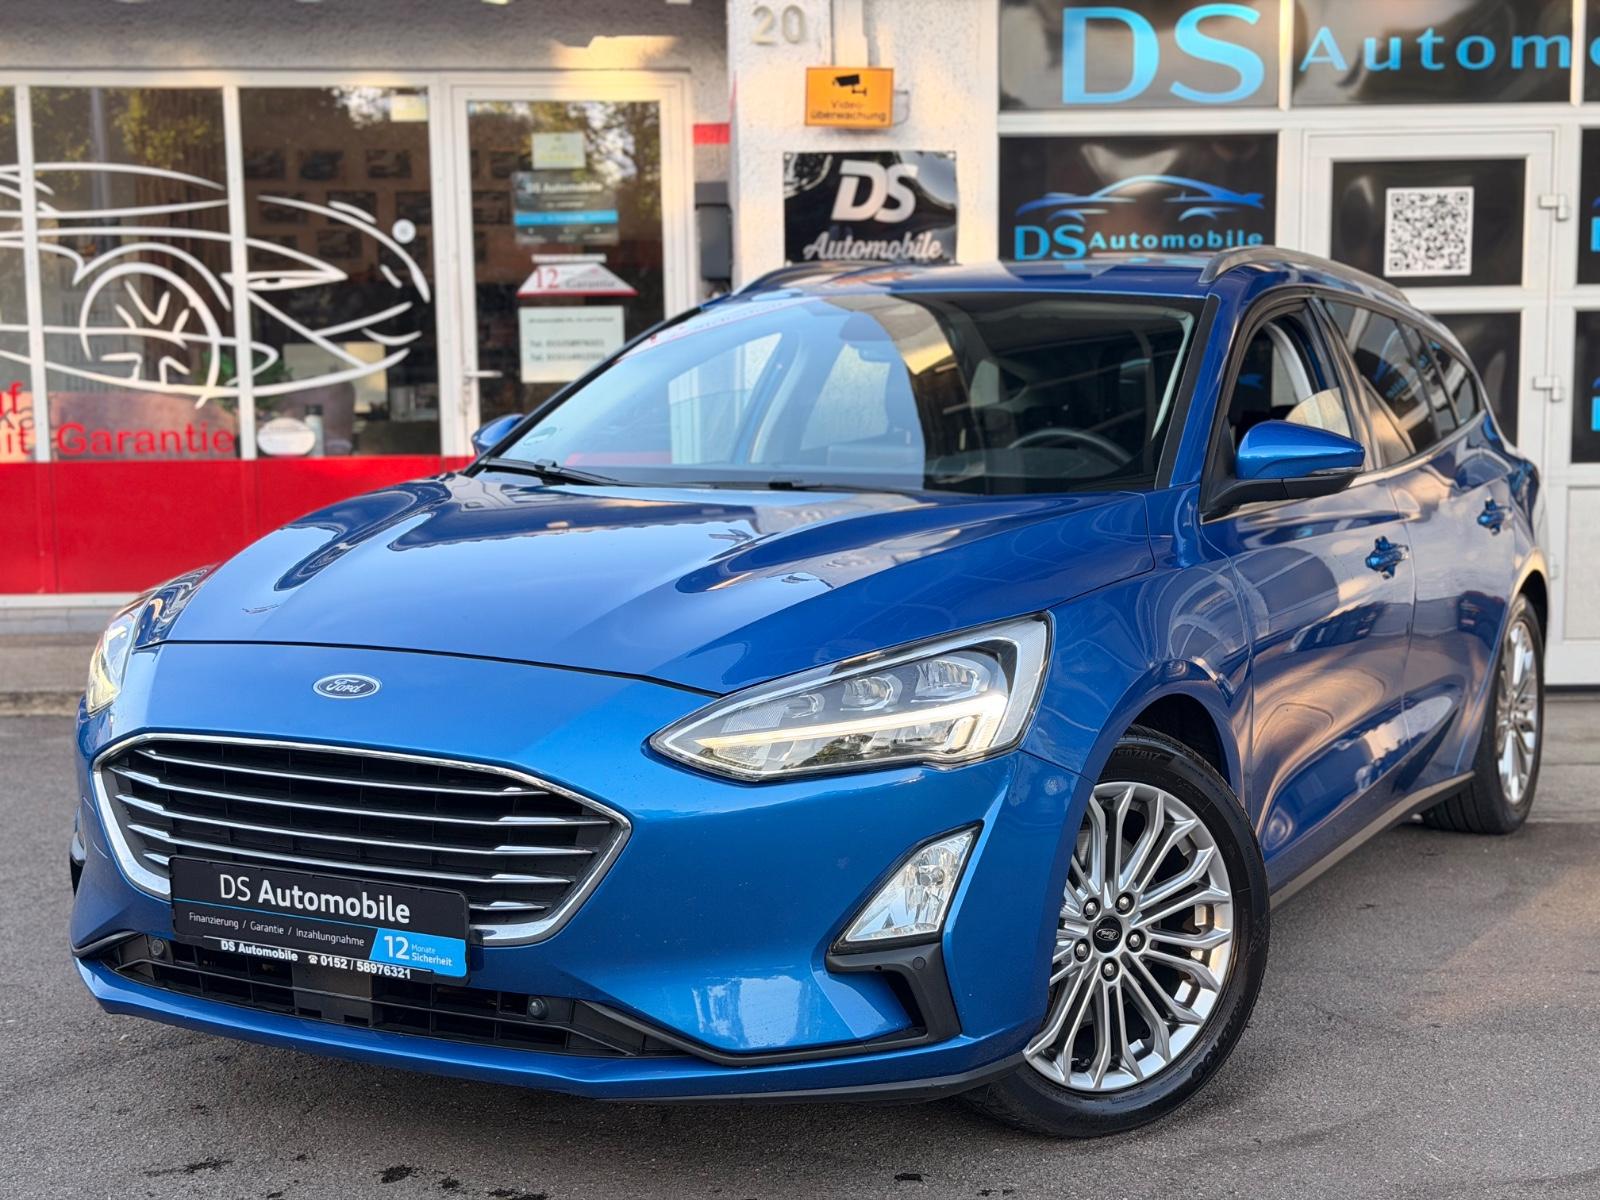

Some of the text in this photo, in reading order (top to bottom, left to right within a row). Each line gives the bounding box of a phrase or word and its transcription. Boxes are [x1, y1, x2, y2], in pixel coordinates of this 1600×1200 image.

[752, 5, 806, 46] 20
[1062, 3, 1600, 104] DS Autom
[831, 160, 919, 223] DS
[803, 231, 943, 260] Automobile
[1014, 224, 1264, 261] DS Automobile
[535, 267, 559, 289] 12
[56, 422, 236, 456] Garantie
[326, 678, 366, 693] Ford
[220, 873, 411, 924] DS Automobile
[188, 911, 239, 930] Finanzierung
[250, 921, 285, 935] Garantie
[296, 928, 365, 947] Inzahlungnahme
[221, 940, 236, 952] DS
[238, 943, 299, 961] Automobile
[320, 955, 348, 970] 0152
[356, 961, 412, 980] 58976321
[383, 935, 411, 960] 12
[411, 943, 437, 955] Monate
[411, 952, 453, 967] Sicherheit
